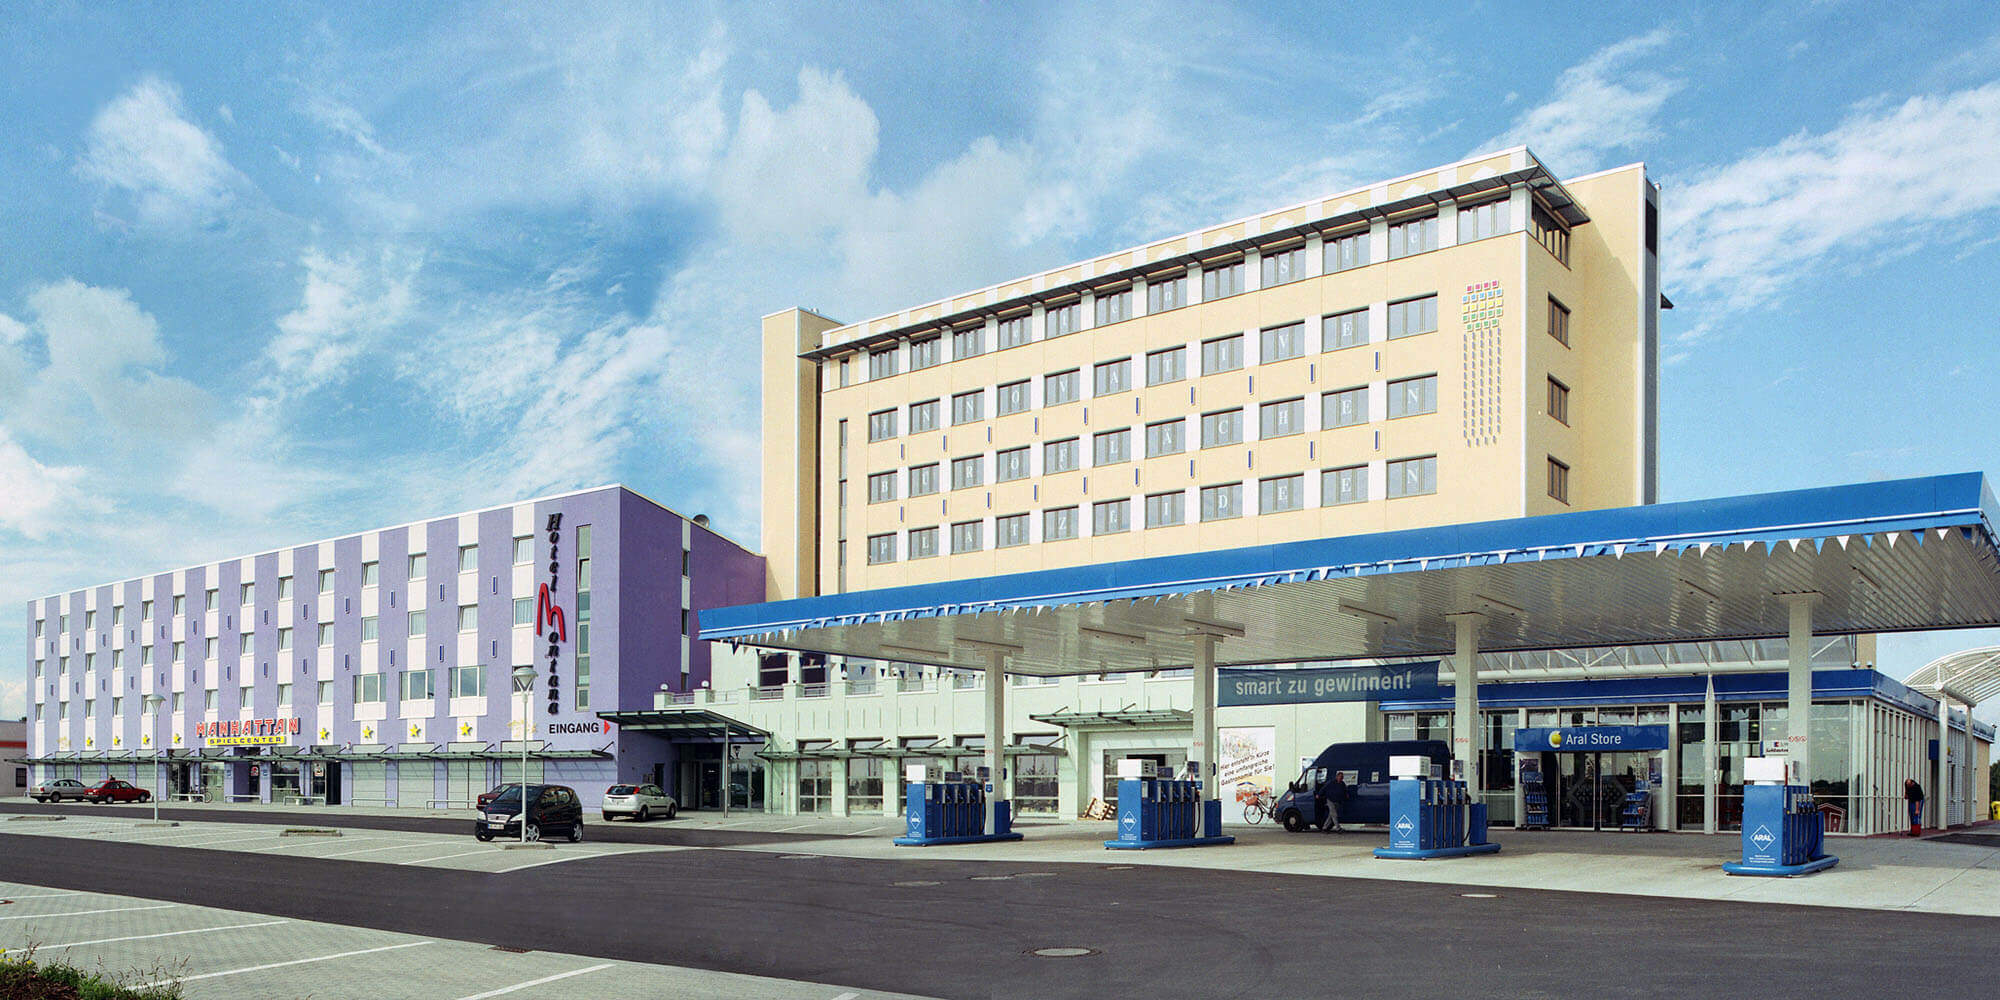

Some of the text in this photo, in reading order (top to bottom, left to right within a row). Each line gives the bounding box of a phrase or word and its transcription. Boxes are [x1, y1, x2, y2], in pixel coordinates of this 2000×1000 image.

[546, 512, 562, 592] Hotel
[536, 582, 566, 715] Montana
[1235, 670, 1412, 696] smart zu gewinnen!
[195, 717, 300, 738] MANHATTAN
[549, 722, 599, 734] EINGANG
[209, 736, 282, 745] SPIELCENTER
[1565, 732, 1622, 745] Aral Store
